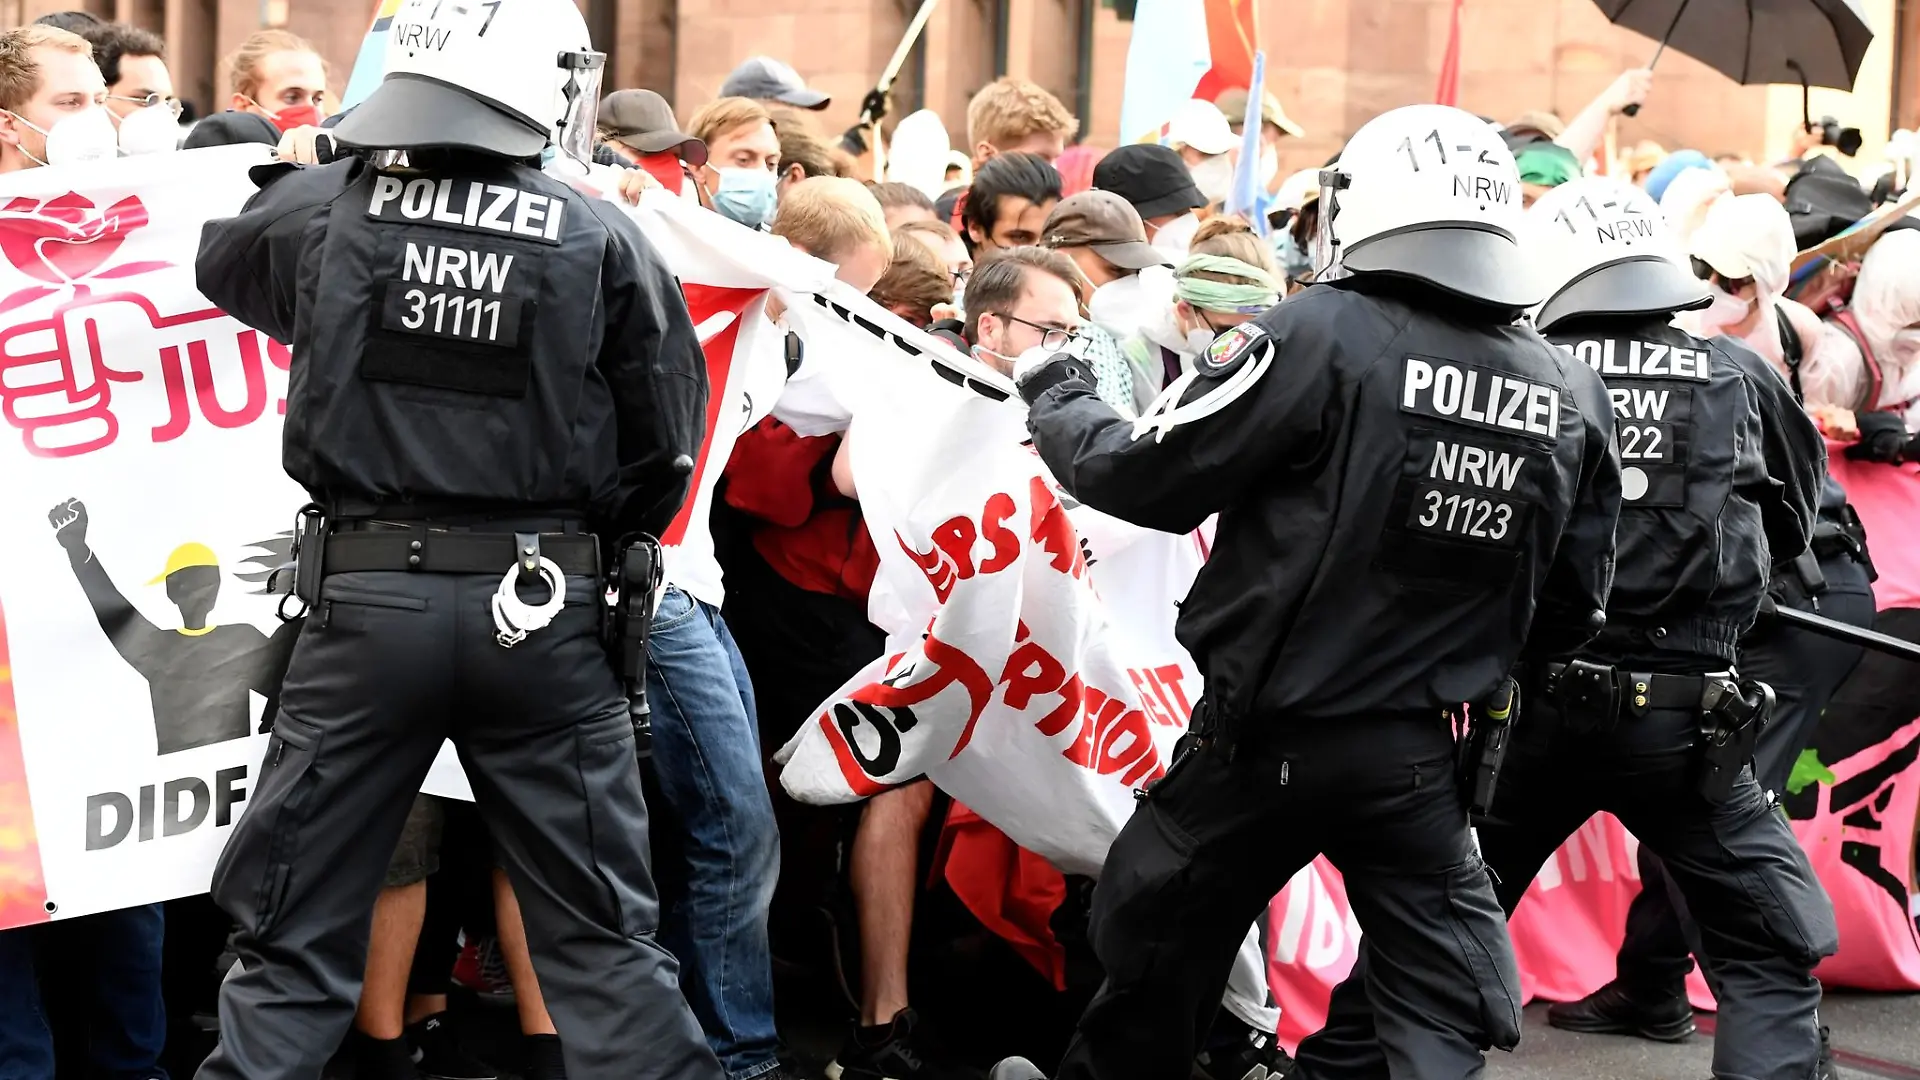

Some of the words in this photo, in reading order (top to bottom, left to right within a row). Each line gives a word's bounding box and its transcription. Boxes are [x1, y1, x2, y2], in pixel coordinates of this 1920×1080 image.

[394, 23, 451, 51] NRW
[368, 175, 564, 241] POLIZEI
[1453, 174, 1511, 205] NRW
[1597, 219, 1653, 244] NRW
[402, 242, 514, 293] NRW
[401, 288, 501, 341] 31111
[1555, 339, 1708, 380] OLIZEI
[1403, 358, 1559, 438] POLIZEI
[1611, 388, 1670, 421] RW
[1429, 441, 1526, 491] NRW
[1621, 425, 1663, 459] 22
[1418, 490, 1513, 540] 31123
[85, 764, 248, 851] DIDF
